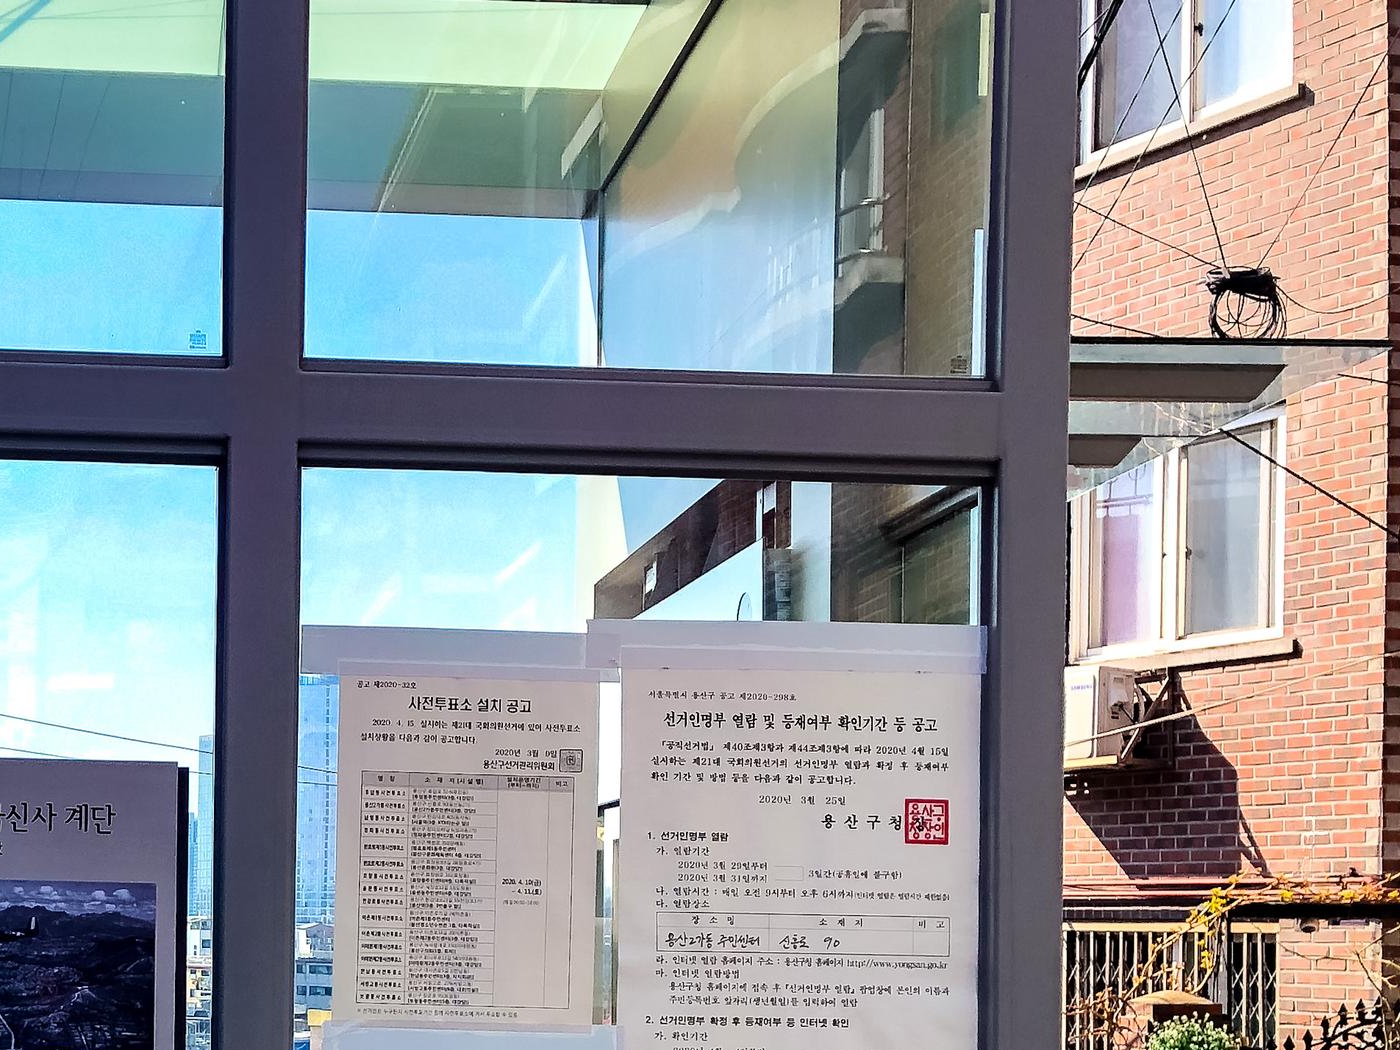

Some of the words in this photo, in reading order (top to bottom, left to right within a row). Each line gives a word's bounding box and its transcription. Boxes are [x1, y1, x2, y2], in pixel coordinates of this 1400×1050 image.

[408, 695, 472, 711] 사전투표소
[477, 698, 501, 712] 설치
[506, 699, 531, 714] 공고
[663, 710, 726, 728] 선거인명부
[732, 712, 757, 729] 열람
[763, 712, 774, 730] 및
[781, 713, 832, 730] 등재여부
[837, 714, 887, 732] 확인기간
[893, 716, 906, 732] 등
[912, 717, 937, 732] 공고
[758, 794, 791, 804] 2020년
[800, 795, 814, 805] 3월
[825, 795, 845, 805] 25일
[64, 803, 116, 834] 계단
[647, 831, 655, 839] 1.
[660, 830, 706, 841] 선거인명부
[711, 832, 728, 842] 열람
[645, 1015, 654, 1024] 2.
[659, 1015, 705, 1026] 선거인명부
[710, 1016, 727, 1026] 확정
[731, 1016, 740, 1026] 후
[744, 1016, 781, 1027] 등재여부
[786, 1017, 795, 1027] 등
[799, 1017, 827, 1028] 인터넷
[832, 1018, 848, 1028] 확인
